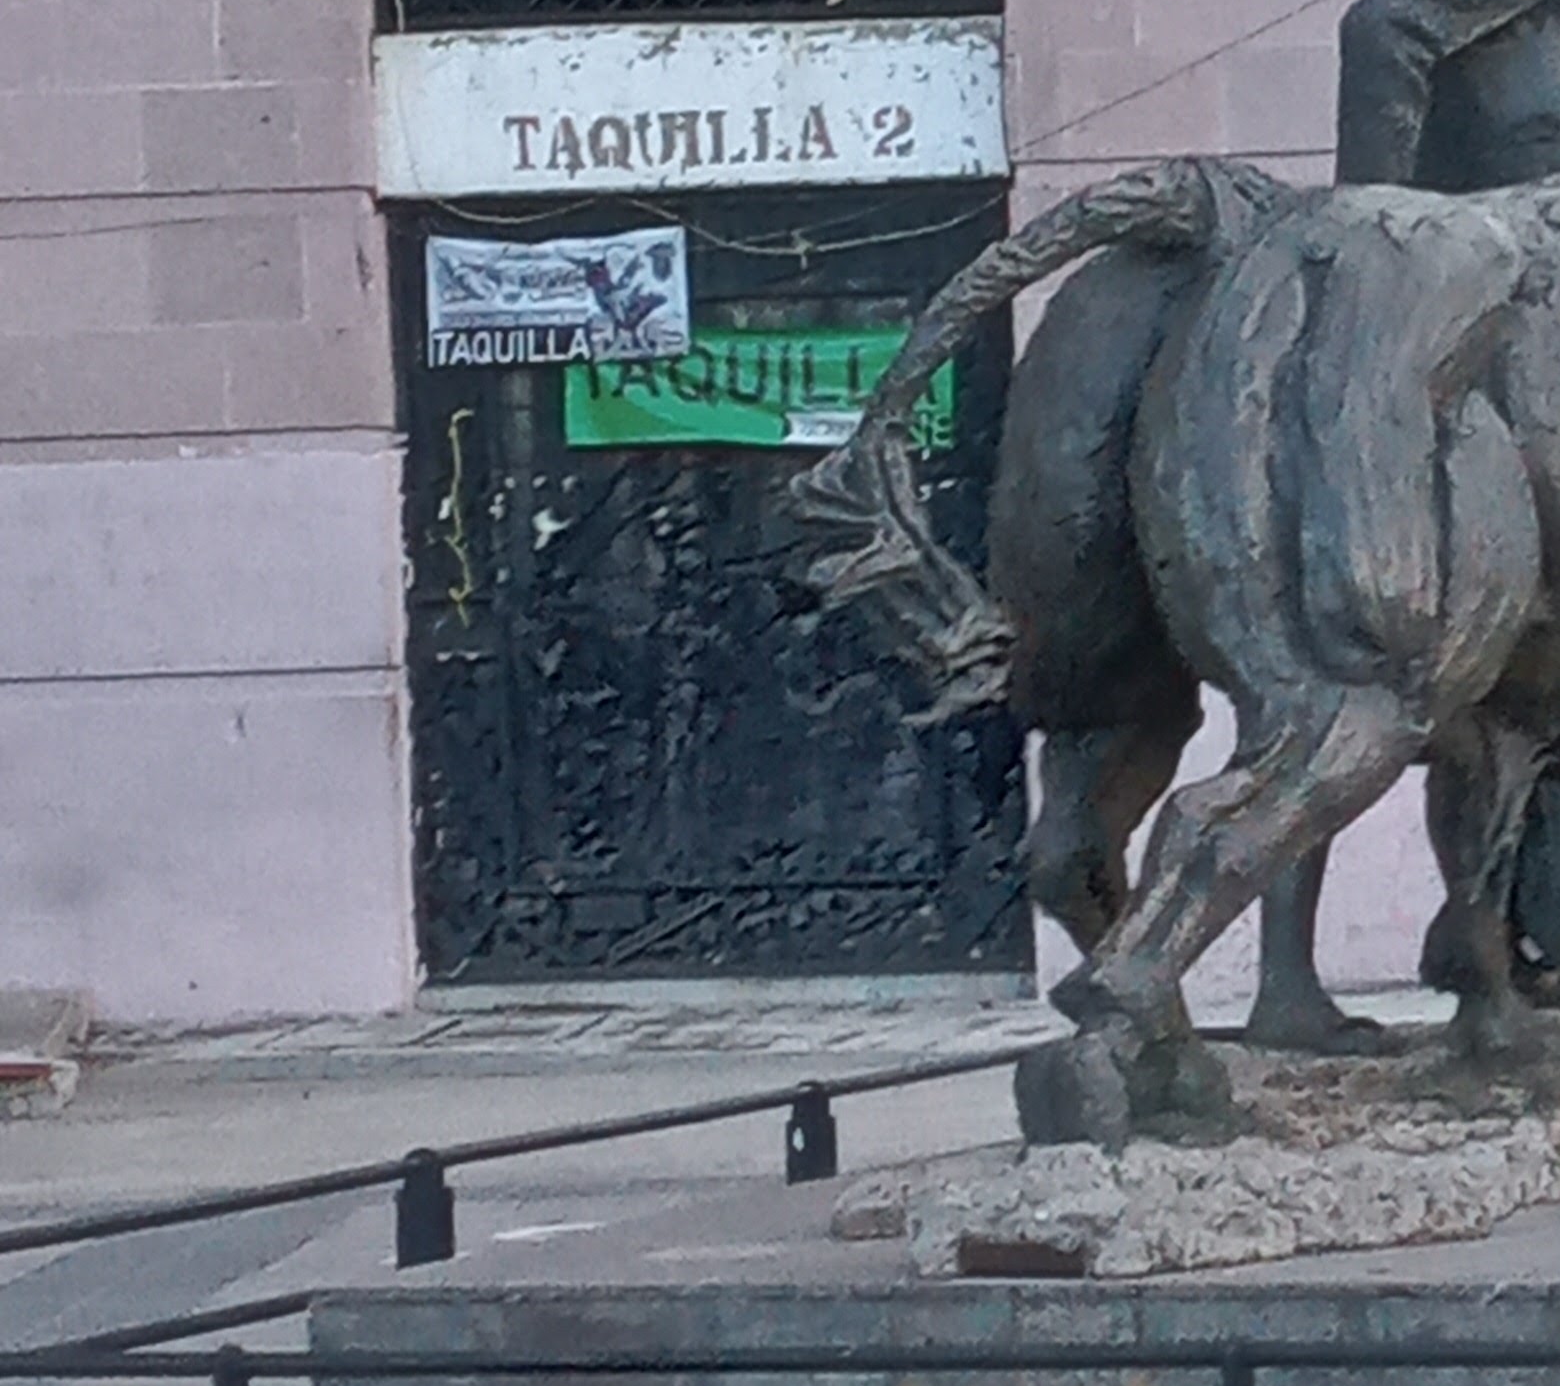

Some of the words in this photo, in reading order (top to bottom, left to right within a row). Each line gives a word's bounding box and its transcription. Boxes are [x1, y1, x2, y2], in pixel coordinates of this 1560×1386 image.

[503, 104, 838, 178] TAQUILLA
[871, 105, 916, 158] 2
[432, 327, 591, 367] TAQUILLA
